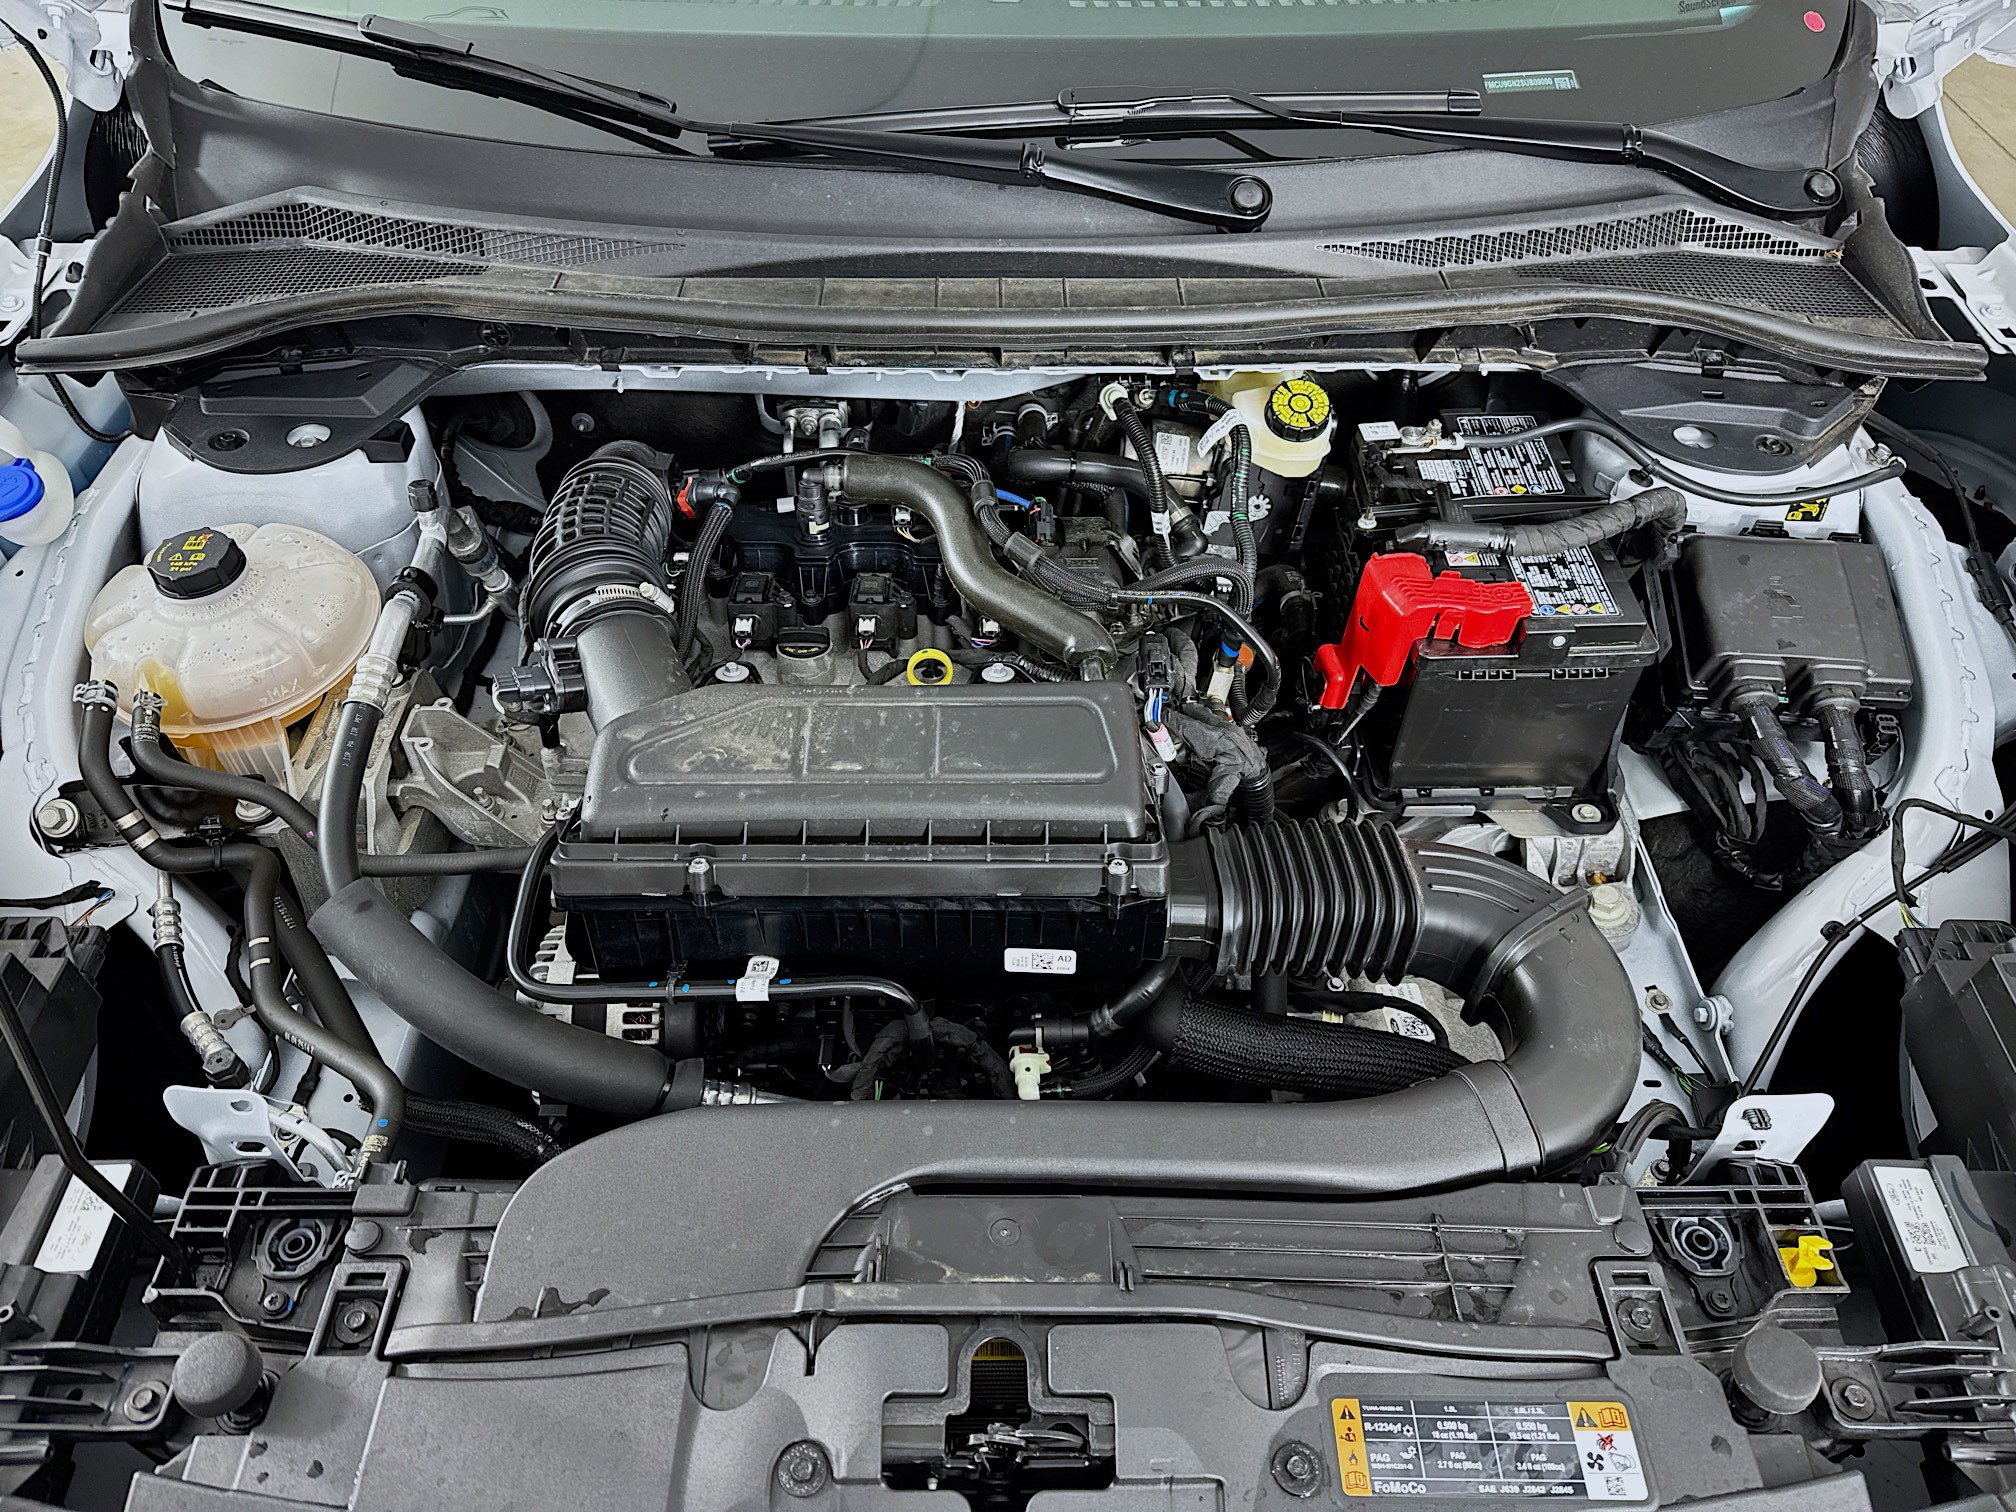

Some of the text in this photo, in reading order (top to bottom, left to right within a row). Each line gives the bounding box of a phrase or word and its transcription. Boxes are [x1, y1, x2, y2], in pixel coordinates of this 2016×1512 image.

[1364, 1422, 1402, 1433] R-1234yf
[1370, 1453, 1391, 1462] PAG
[1450, 1451, 1467, 1460] PAG
[1530, 1453, 1547, 1461] PAG
[1373, 1480, 1427, 1494] FoMoCo
[1478, 1484, 1498, 1493] SAE
